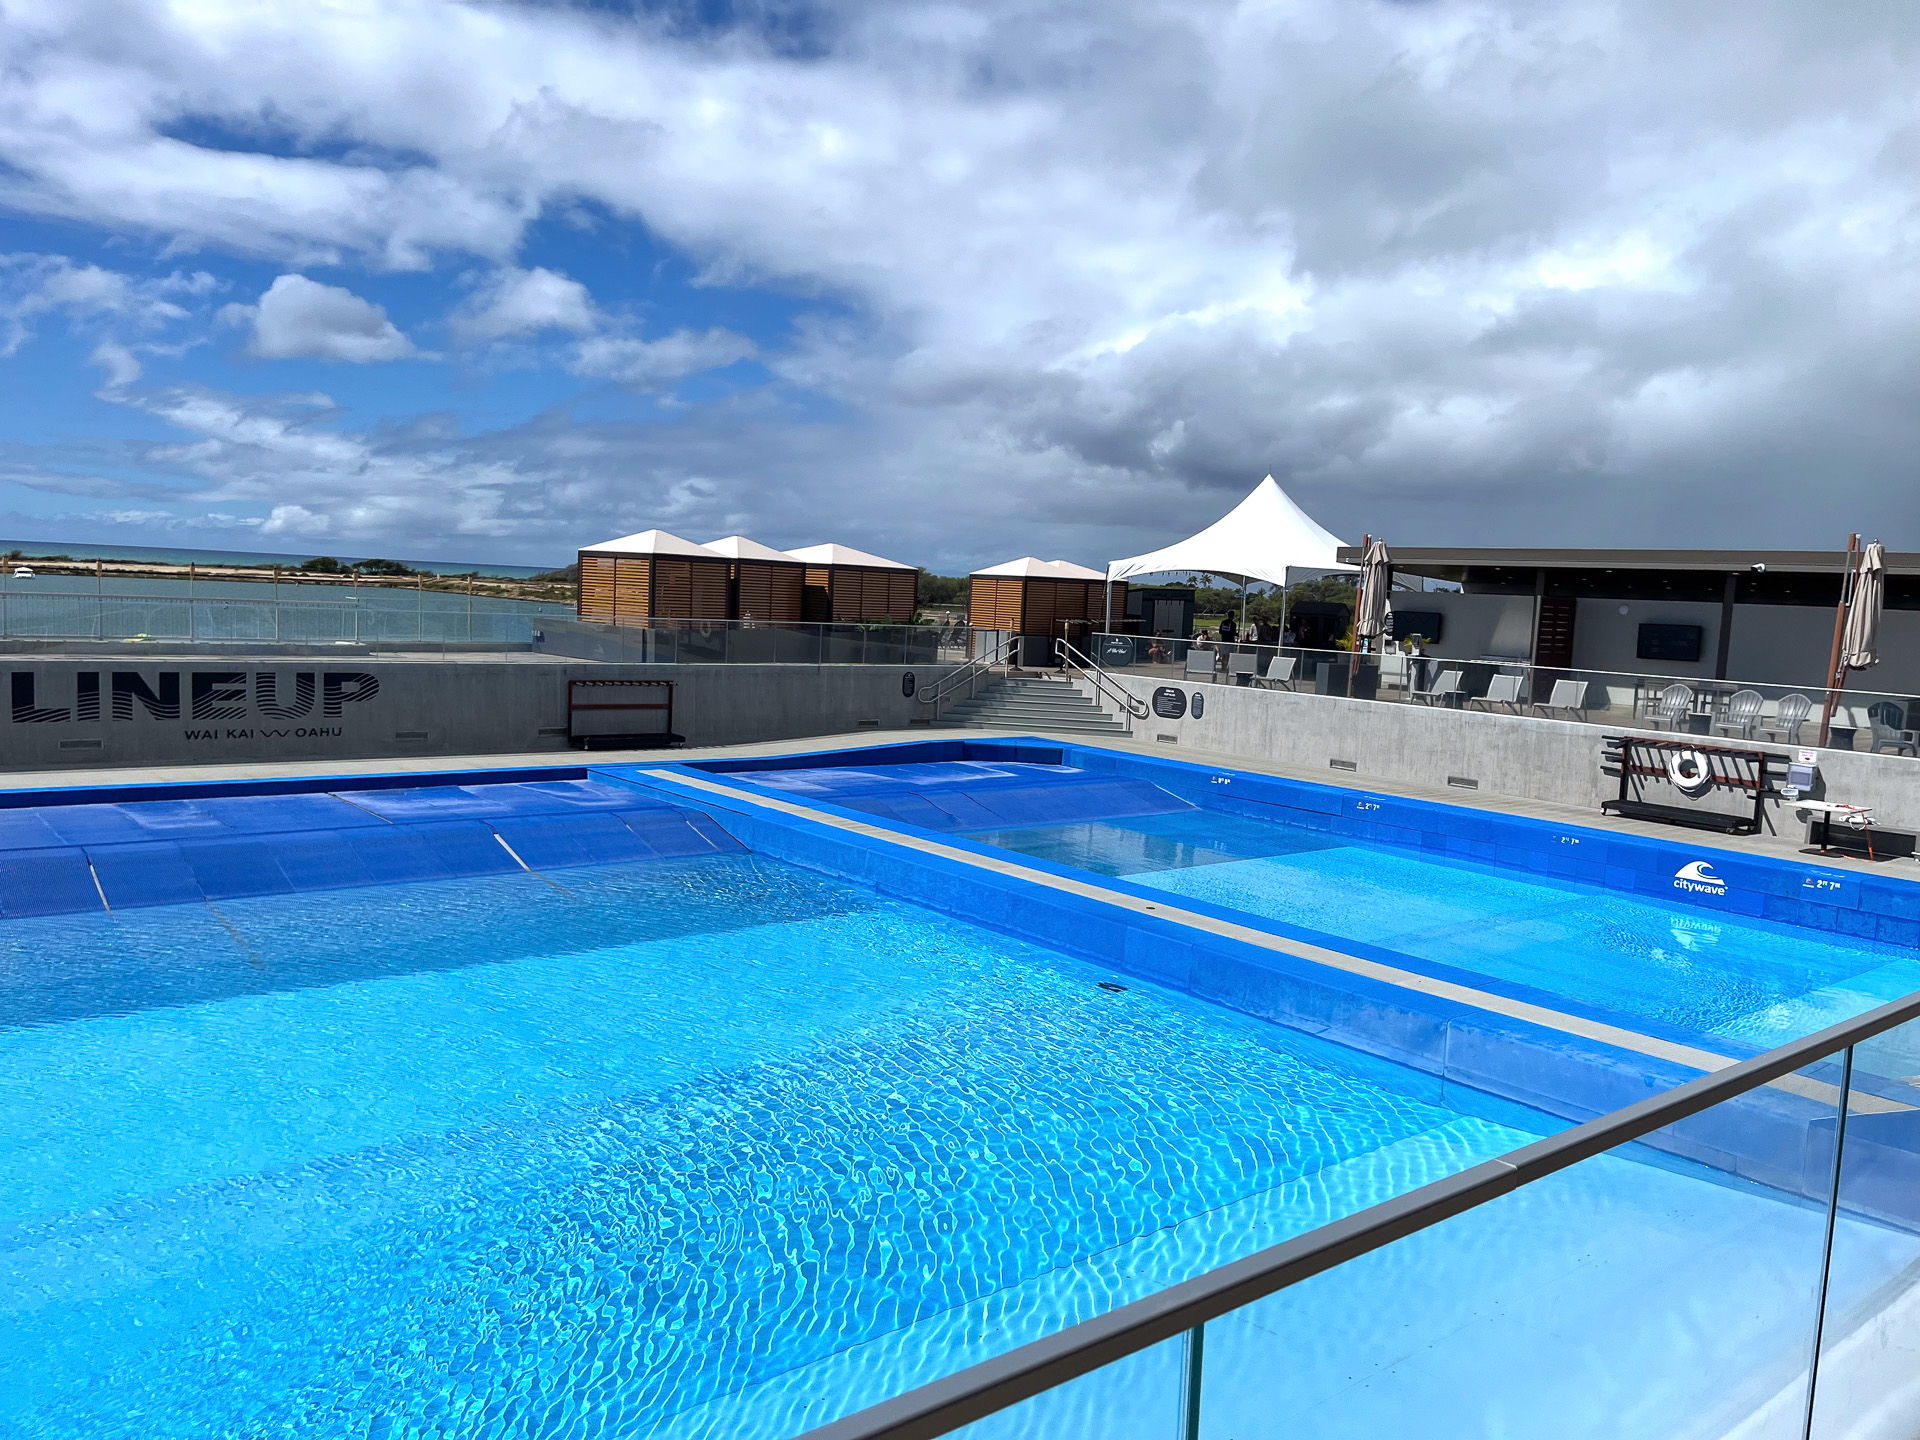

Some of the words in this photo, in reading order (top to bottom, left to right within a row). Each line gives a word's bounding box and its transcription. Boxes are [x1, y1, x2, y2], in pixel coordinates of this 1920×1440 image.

[11, 671, 380, 723] LINEUP
[184, 730, 218, 740] WAI
[227, 729, 254, 739] KAI
[295, 727, 343, 738] OAHU
[1673, 878, 1725, 896] citywave
